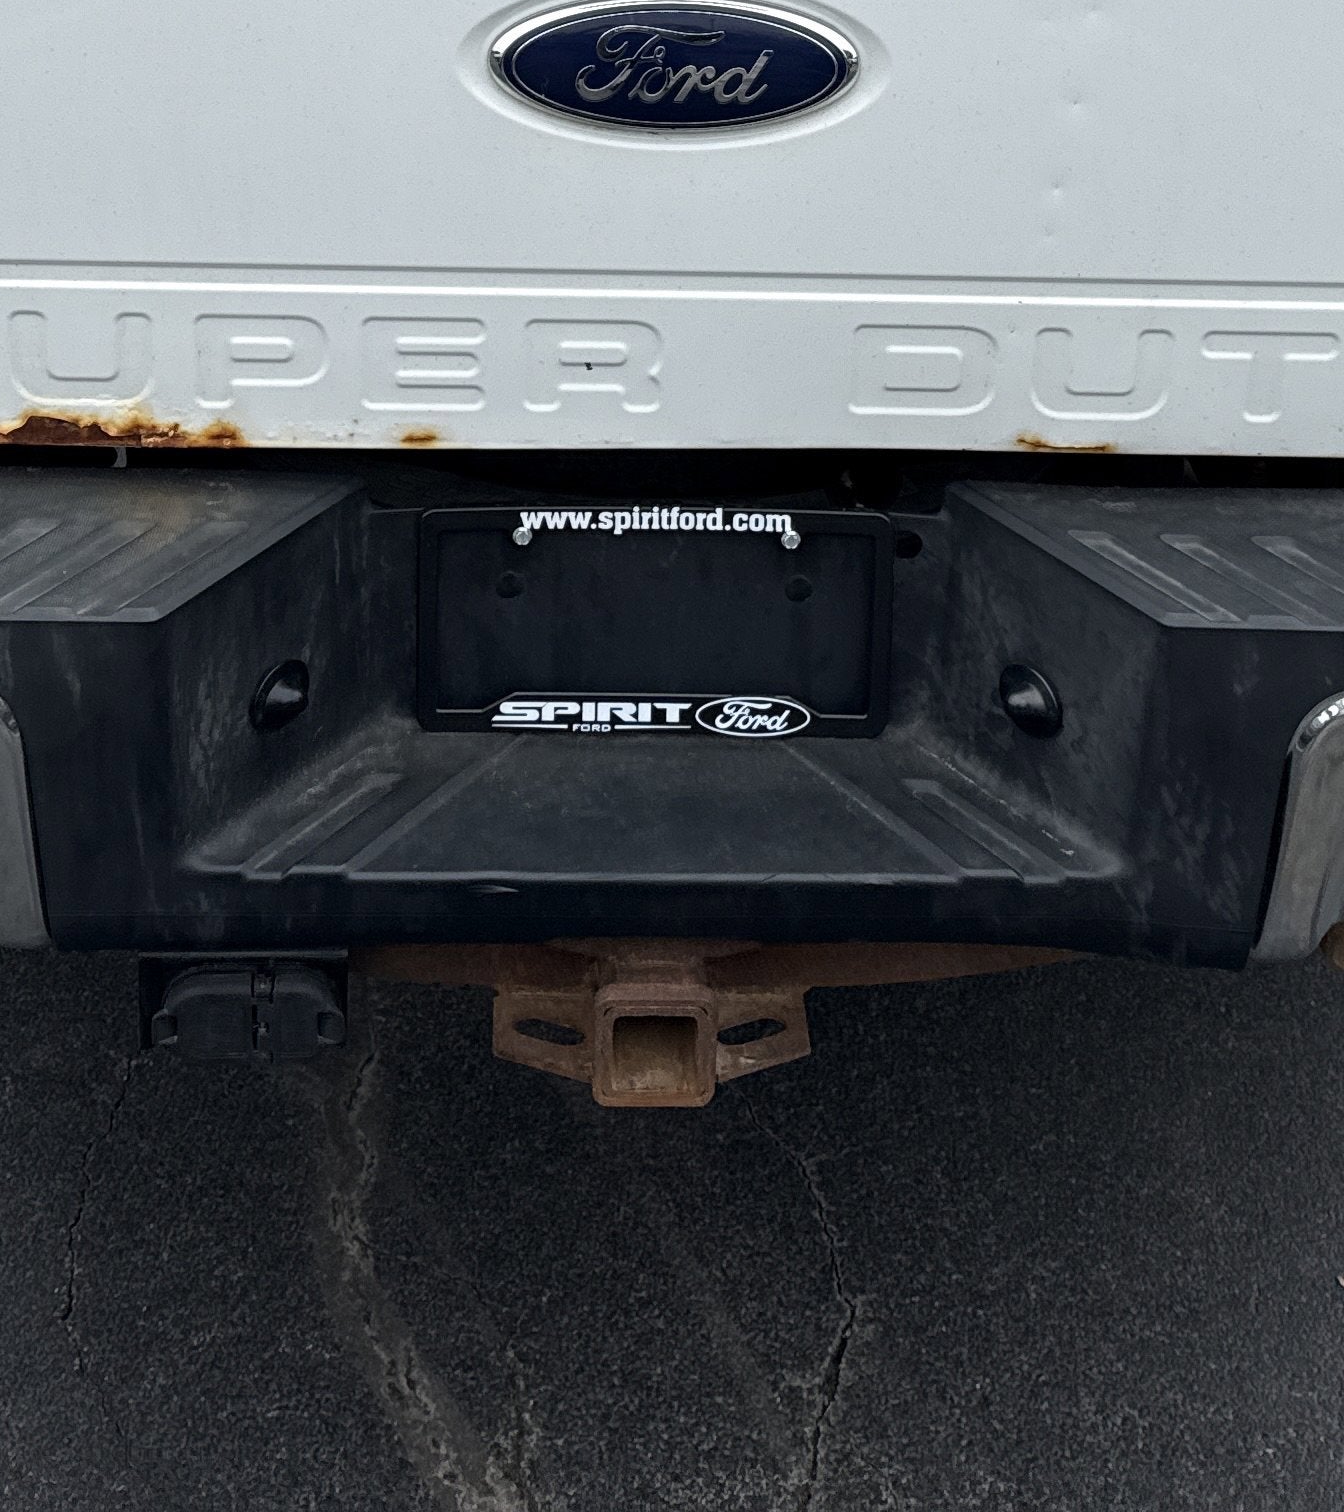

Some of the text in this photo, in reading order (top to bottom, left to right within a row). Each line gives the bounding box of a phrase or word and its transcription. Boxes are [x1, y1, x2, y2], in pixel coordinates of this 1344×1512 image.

[574, 23, 775, 105] Ford
[519, 505, 793, 535] www.spiritford.com
[490, 700, 792, 733] SPIRIT Ford
[571, 724, 612, 733] FORD
